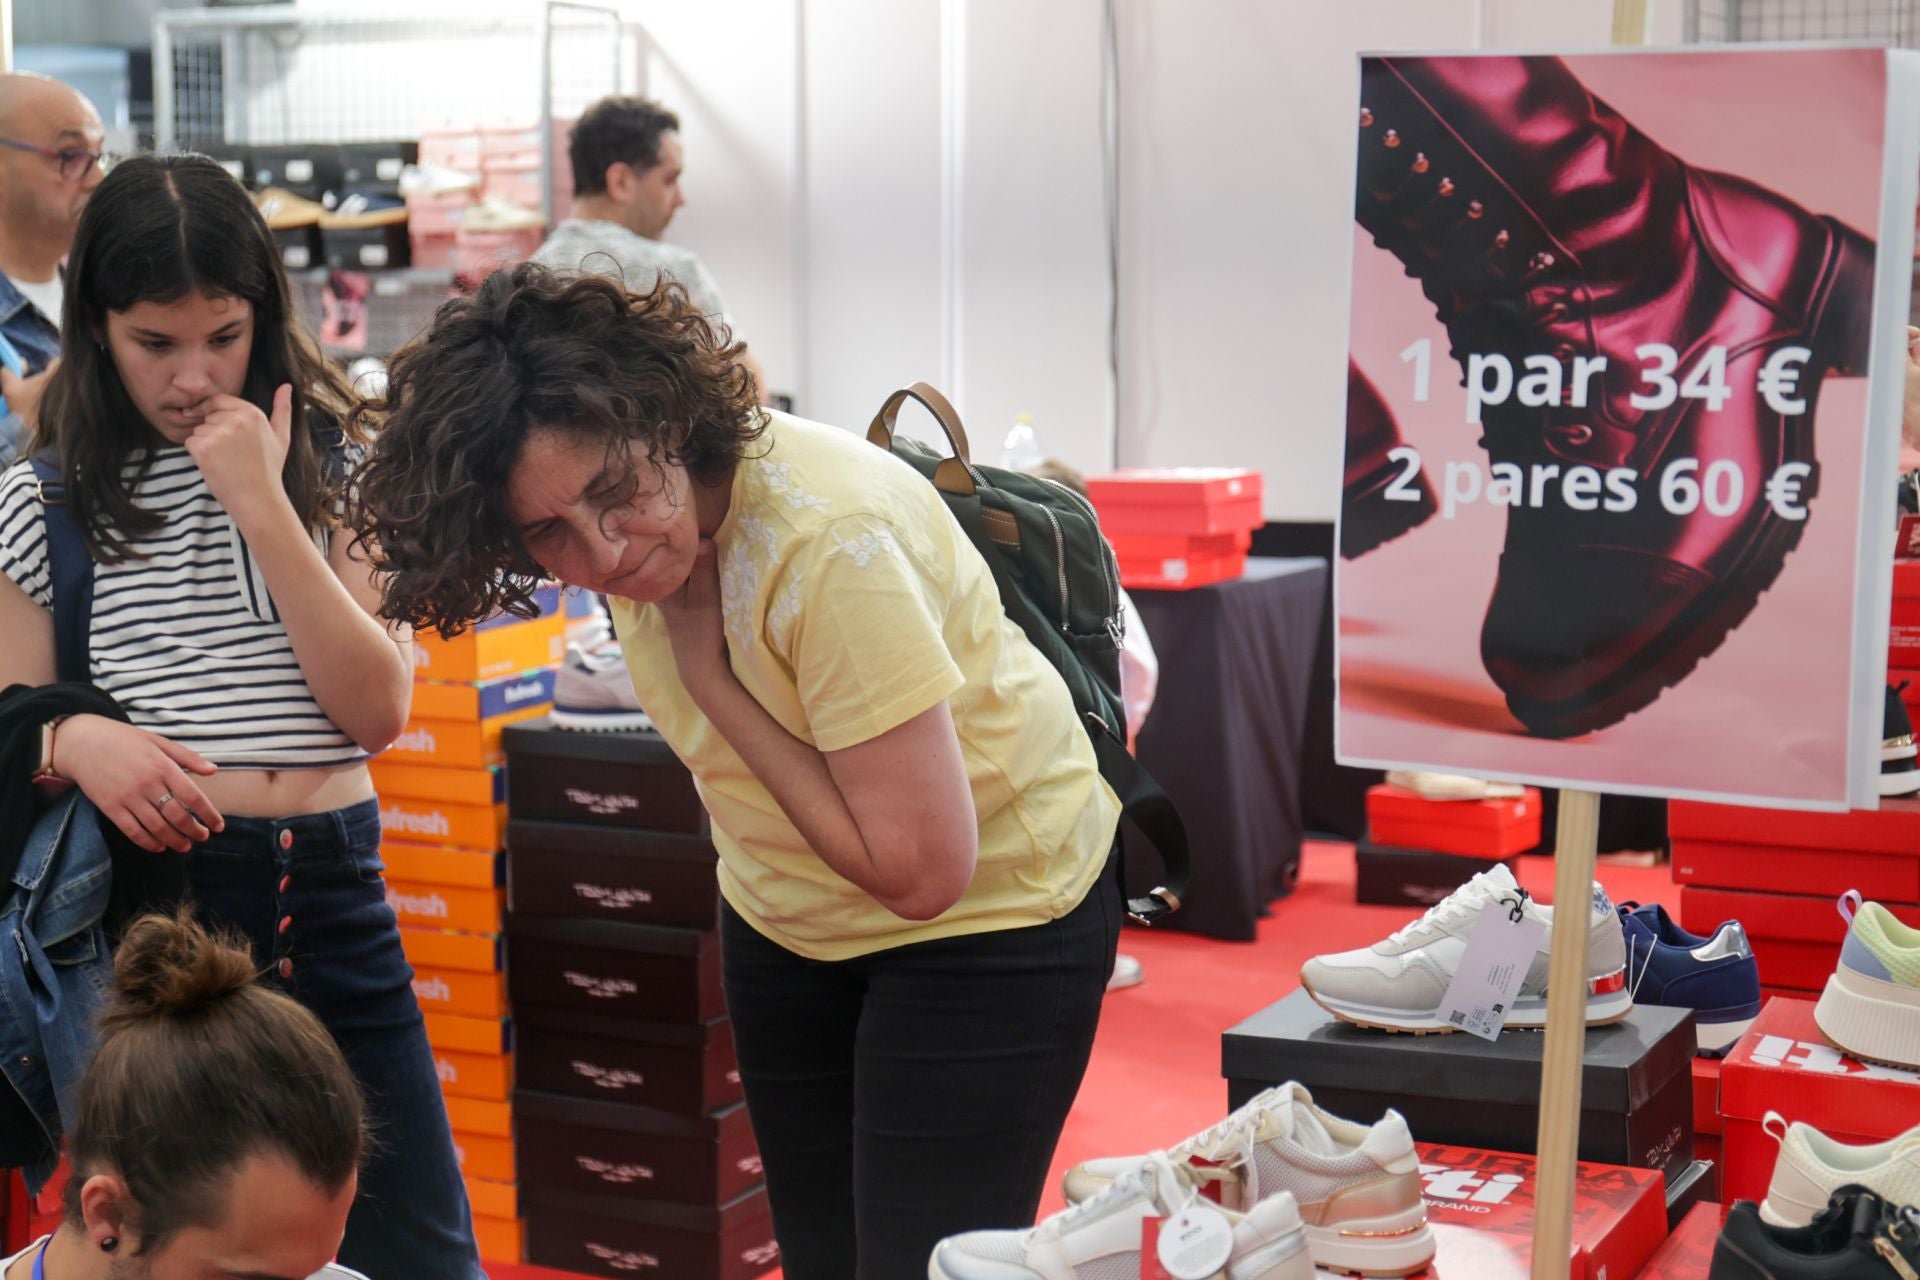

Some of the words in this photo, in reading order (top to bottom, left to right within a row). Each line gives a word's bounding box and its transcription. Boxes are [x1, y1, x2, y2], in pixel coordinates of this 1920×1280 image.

[1400, 339, 1432, 401] 1
[1466, 347, 1607, 423] par
[1630, 343, 1731, 411] 34
[1757, 347, 1812, 415] €
[1384, 447, 1421, 501] 2
[1444, 457, 1638, 519] pares
[1659, 458, 1744, 516] 60
[1765, 462, 1811, 521] €
[1419, 1164, 1525, 1204] ti
